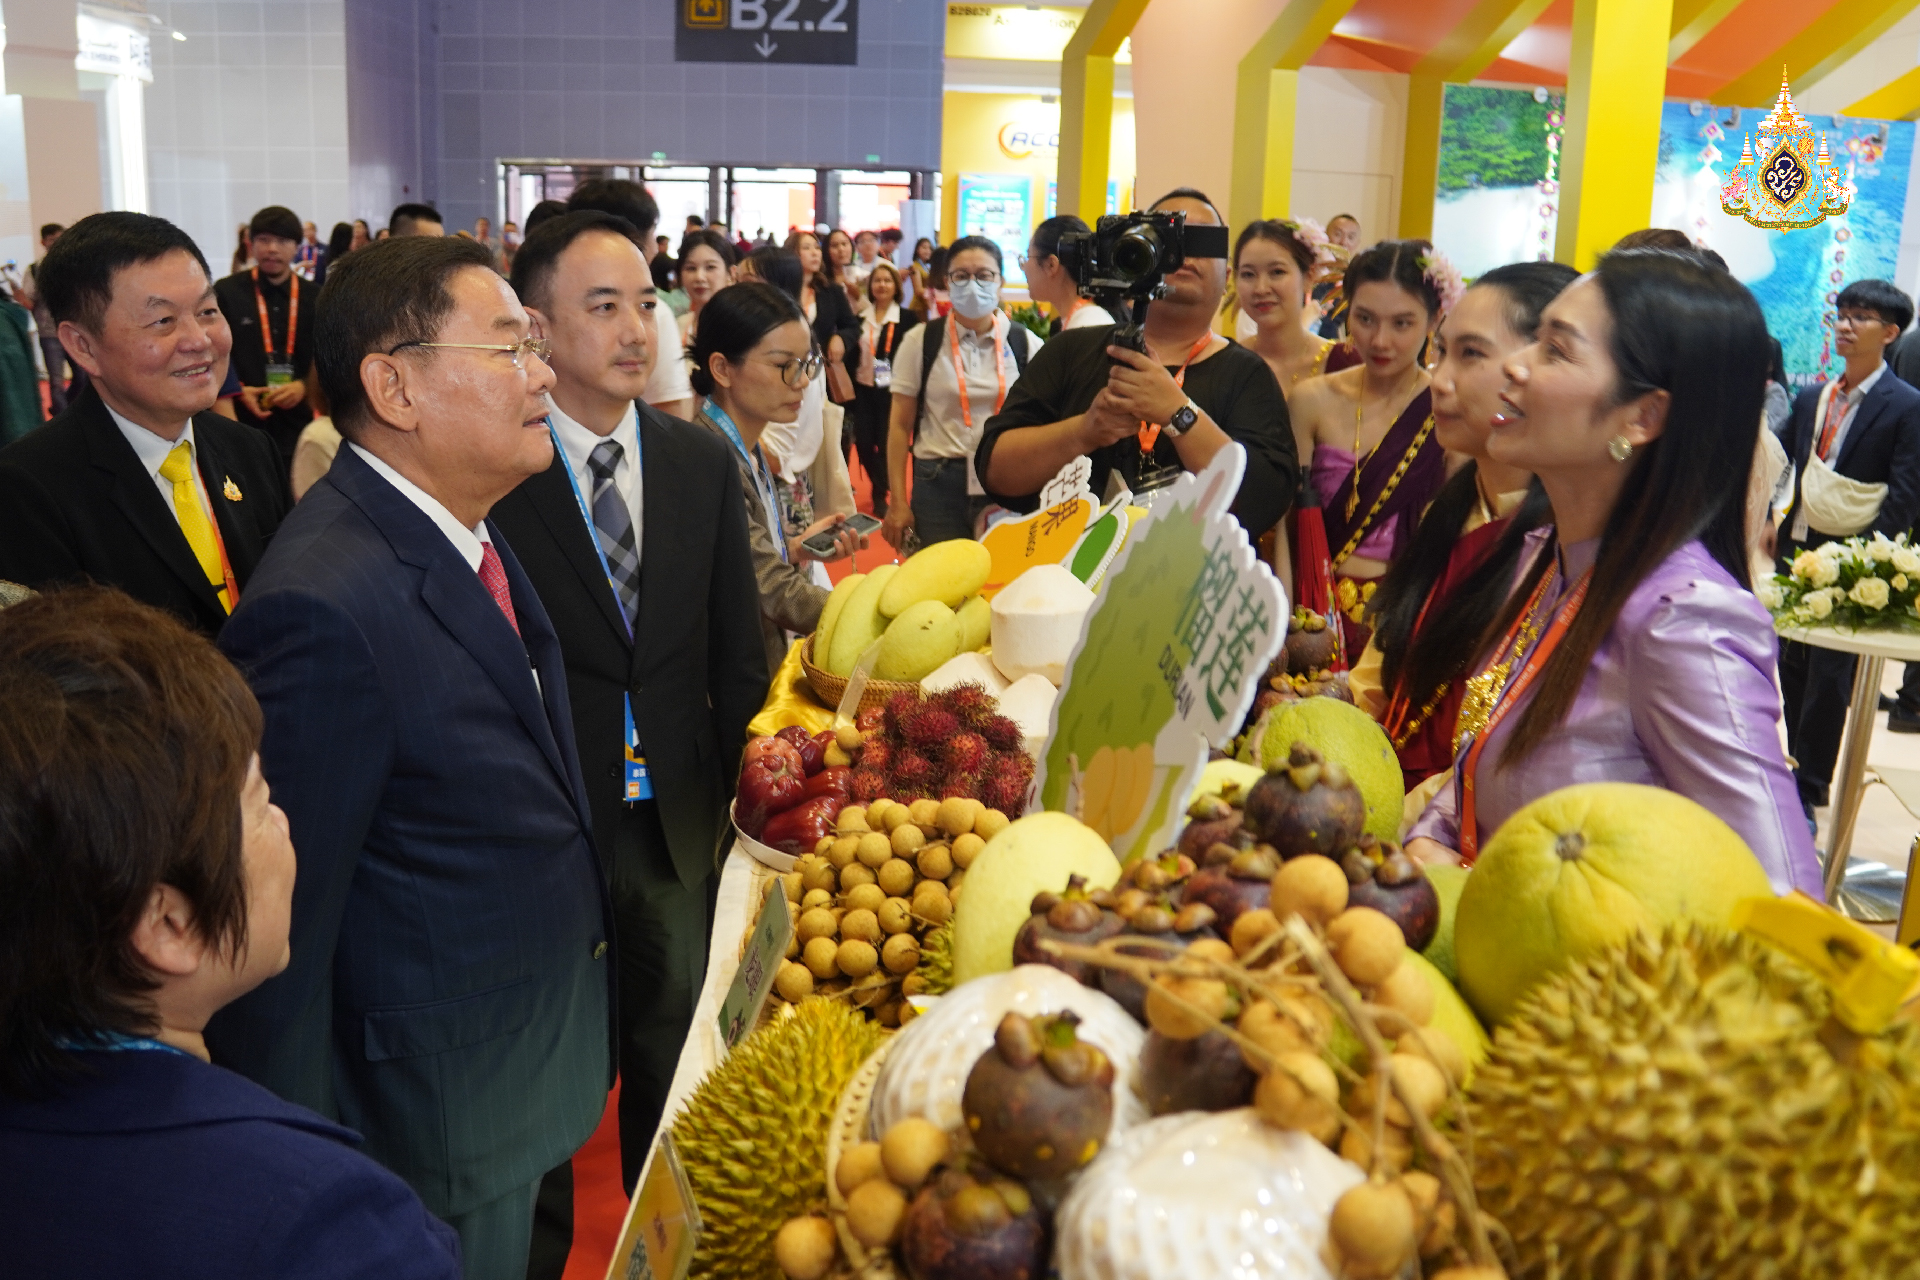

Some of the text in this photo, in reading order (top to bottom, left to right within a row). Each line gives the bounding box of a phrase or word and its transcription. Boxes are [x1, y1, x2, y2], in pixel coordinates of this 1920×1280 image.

[730, 0, 848, 32] B2.2
[1041, 463, 1083, 536] 芒果
[1174, 535, 1269, 722] 榴莲
[1157, 643, 1196, 721] DURIAN
